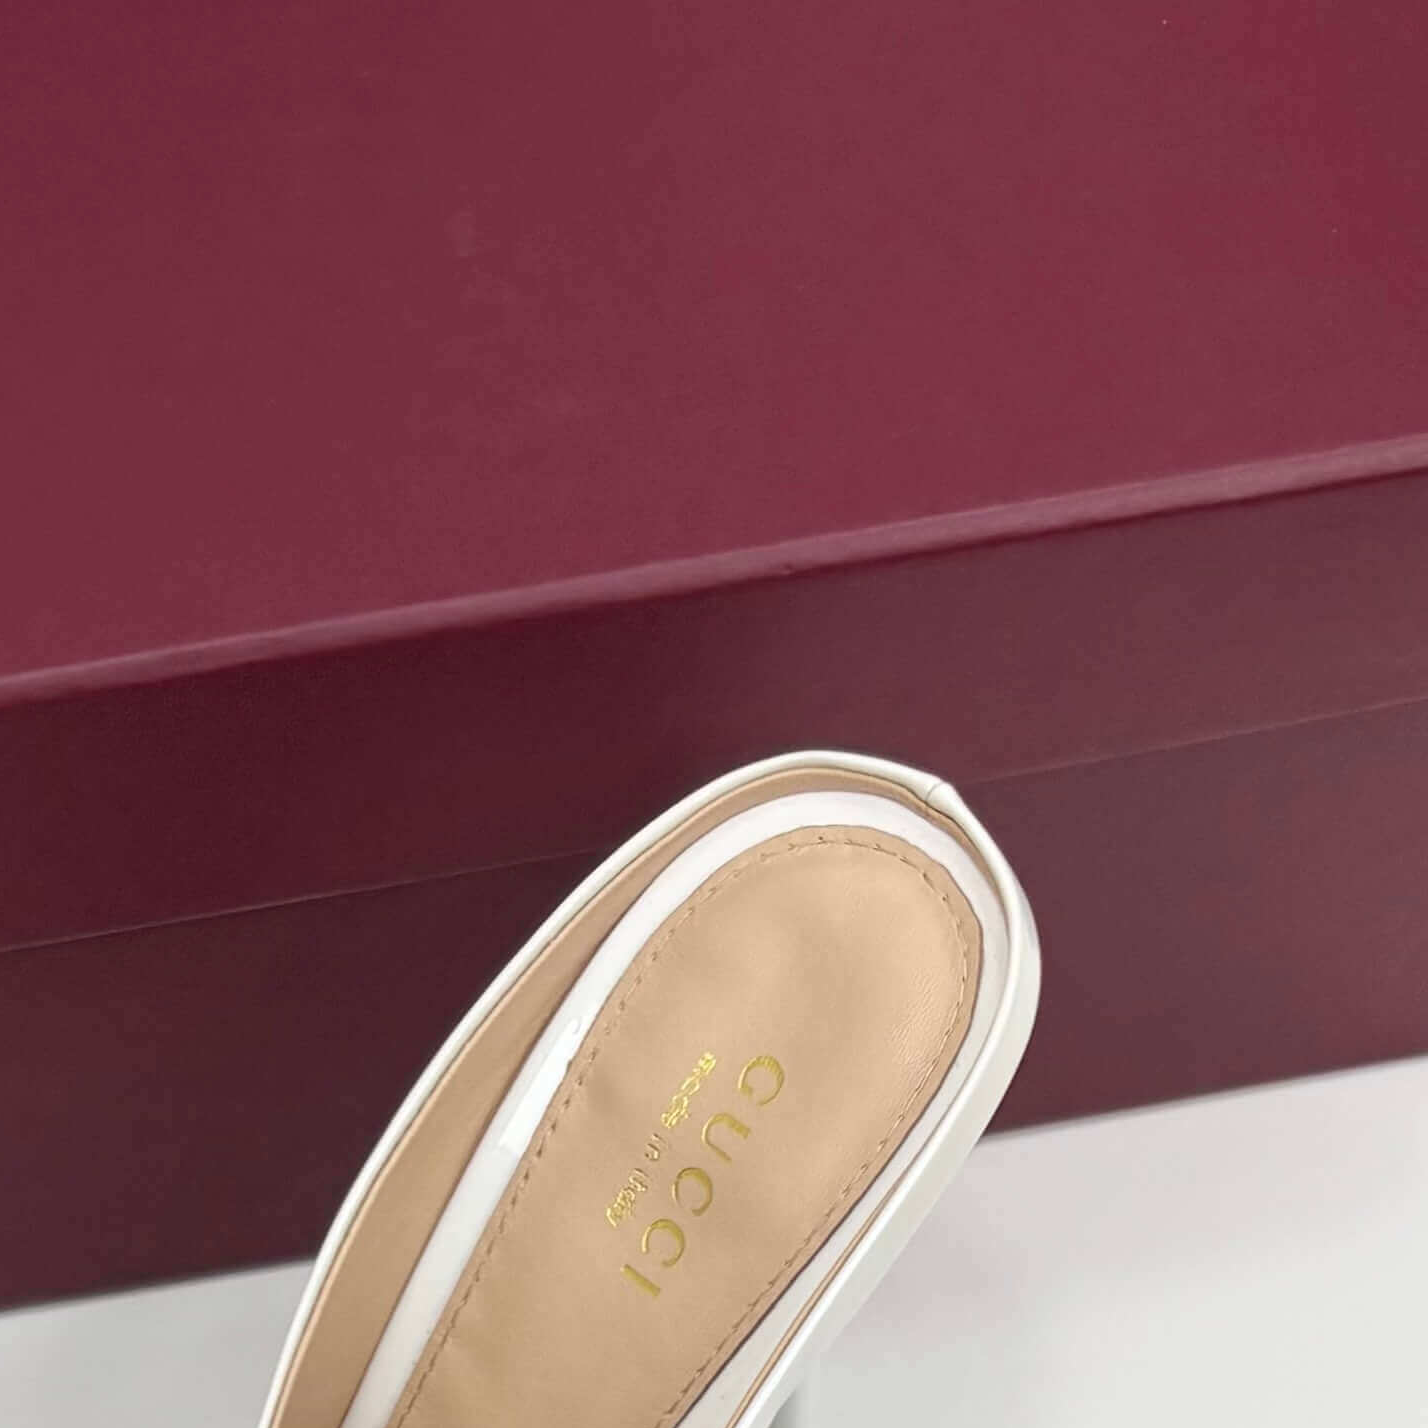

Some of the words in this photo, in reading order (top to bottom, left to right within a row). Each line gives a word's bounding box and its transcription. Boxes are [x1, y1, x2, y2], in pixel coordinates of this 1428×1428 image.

[661, 1052, 717, 1128] made
[620, 1055, 785, 1297] GUCCI
[644, 1132, 668, 1162] in
